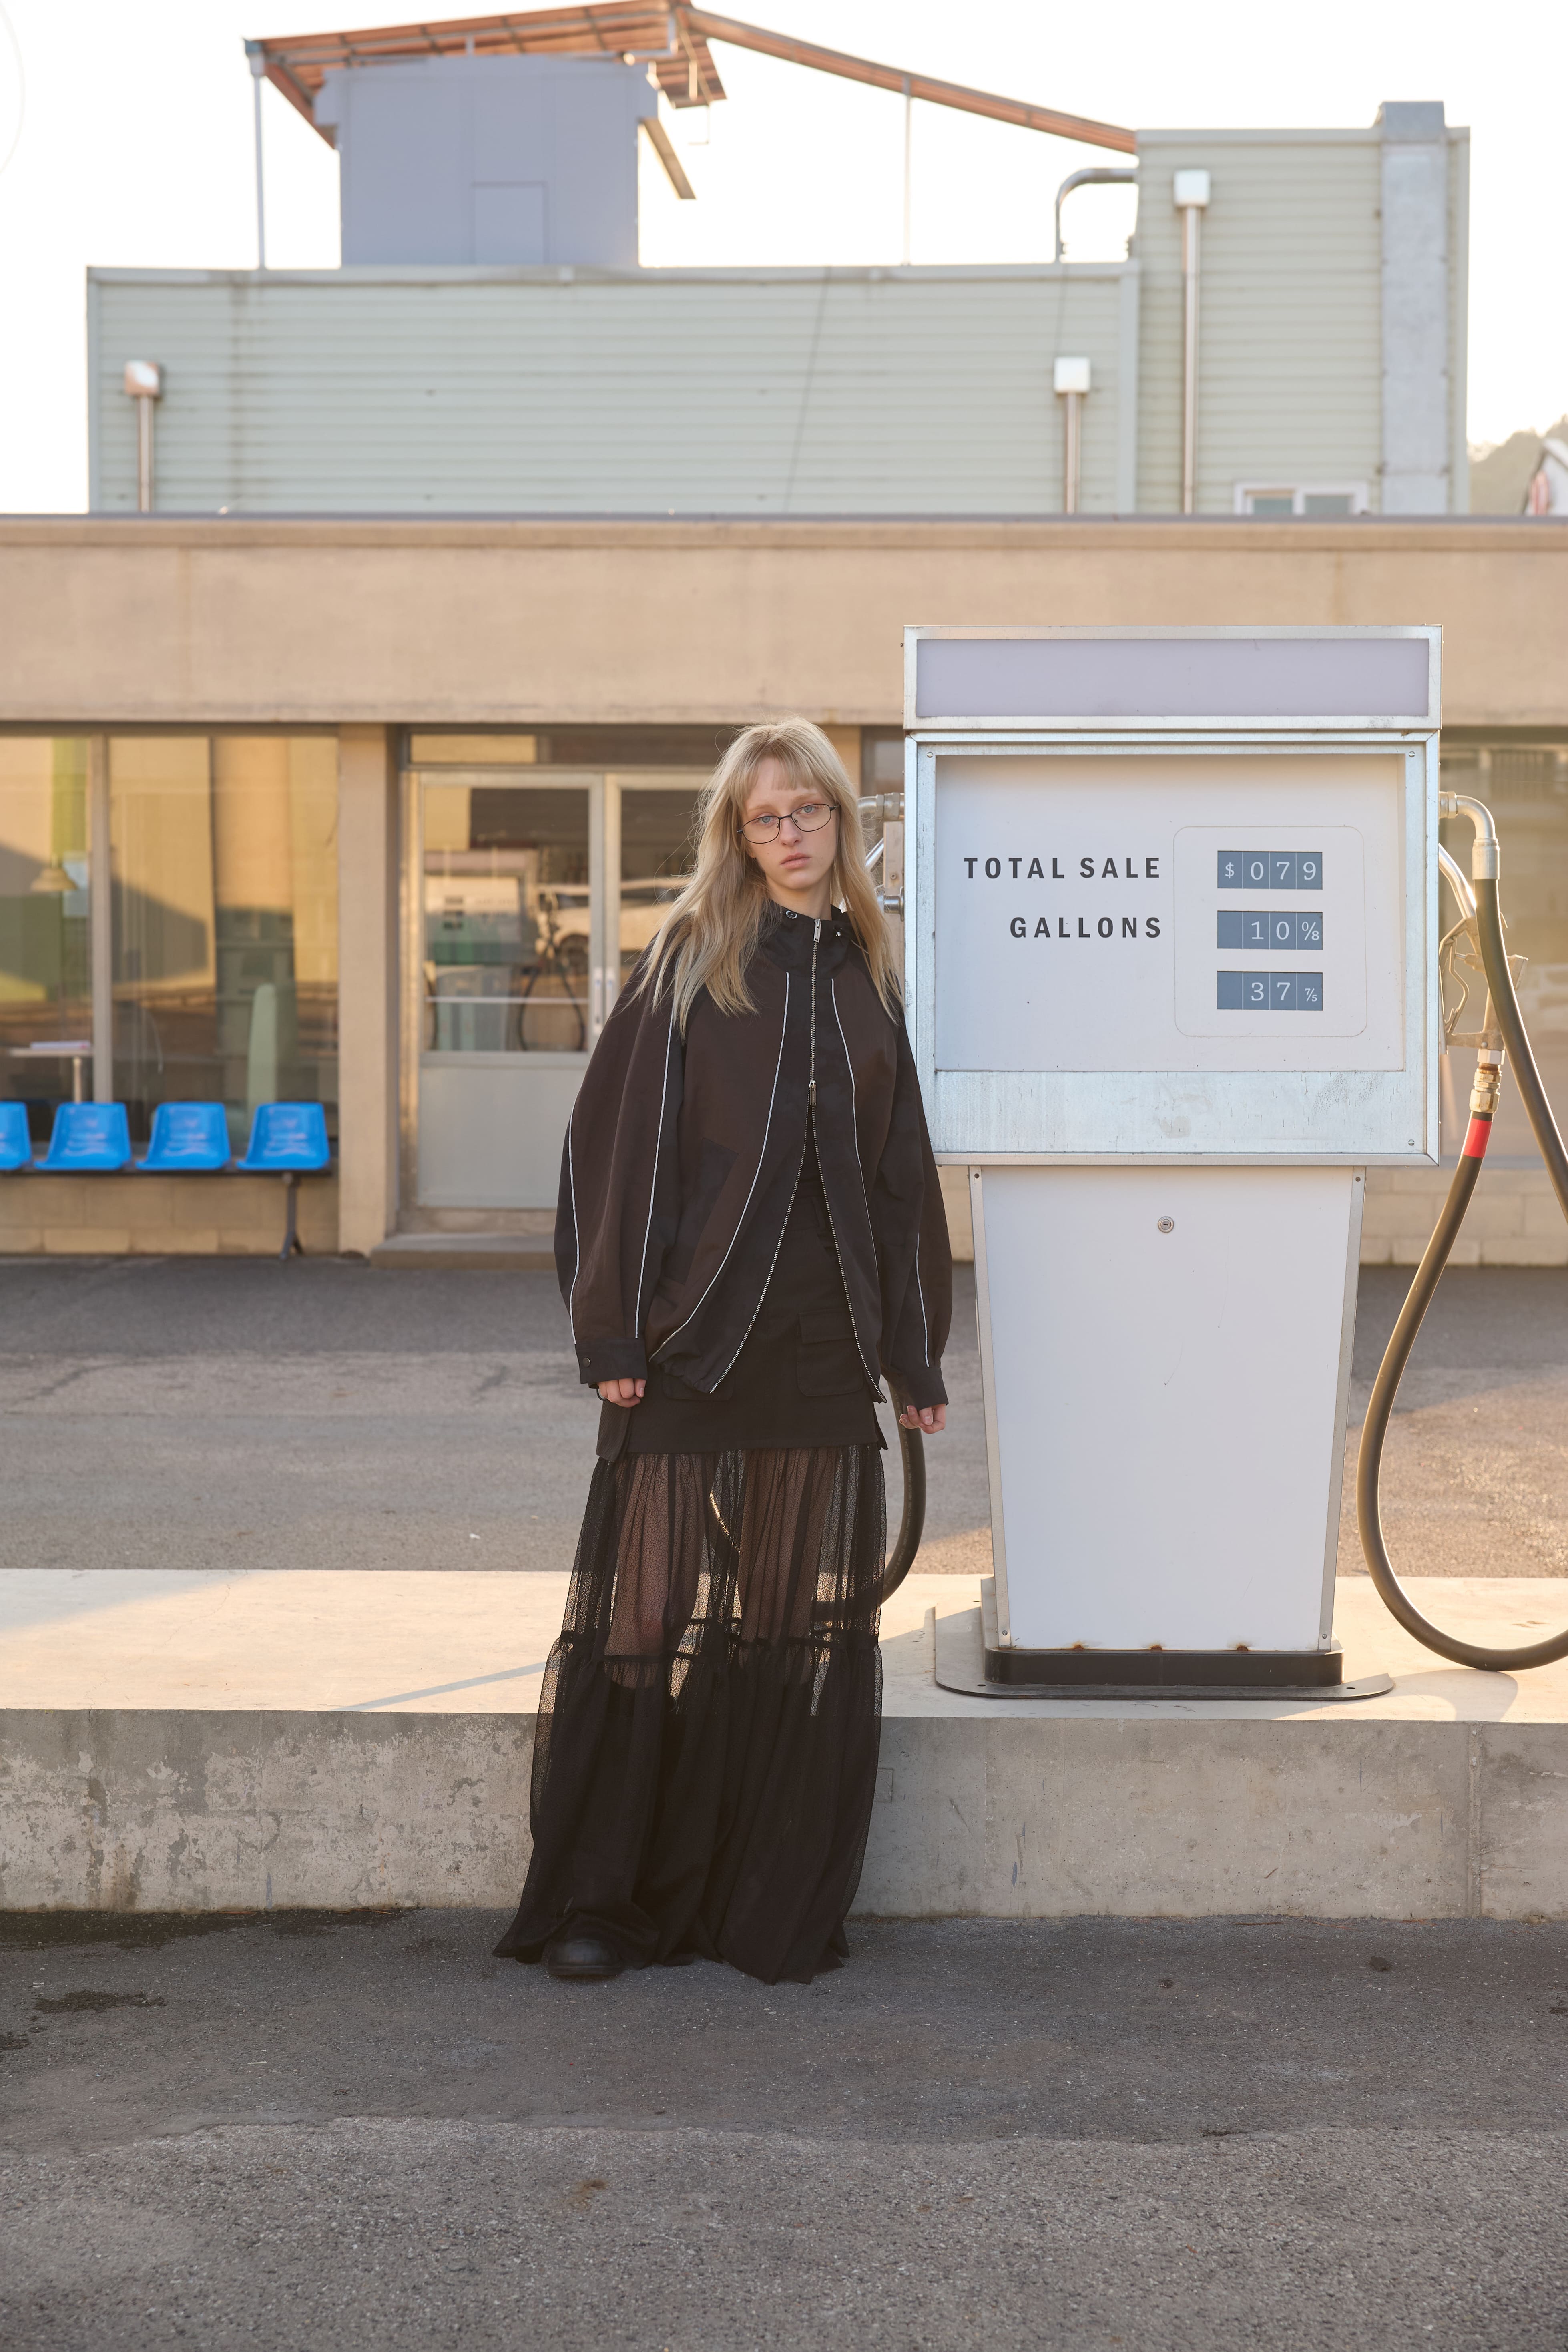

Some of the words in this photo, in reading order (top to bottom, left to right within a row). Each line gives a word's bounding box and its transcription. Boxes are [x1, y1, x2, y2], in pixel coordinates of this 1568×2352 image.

[964, 857, 1064, 879] TOTAL
[1080, 857, 1159, 878] SALE
[1010, 917, 1160, 938] GALLONS
